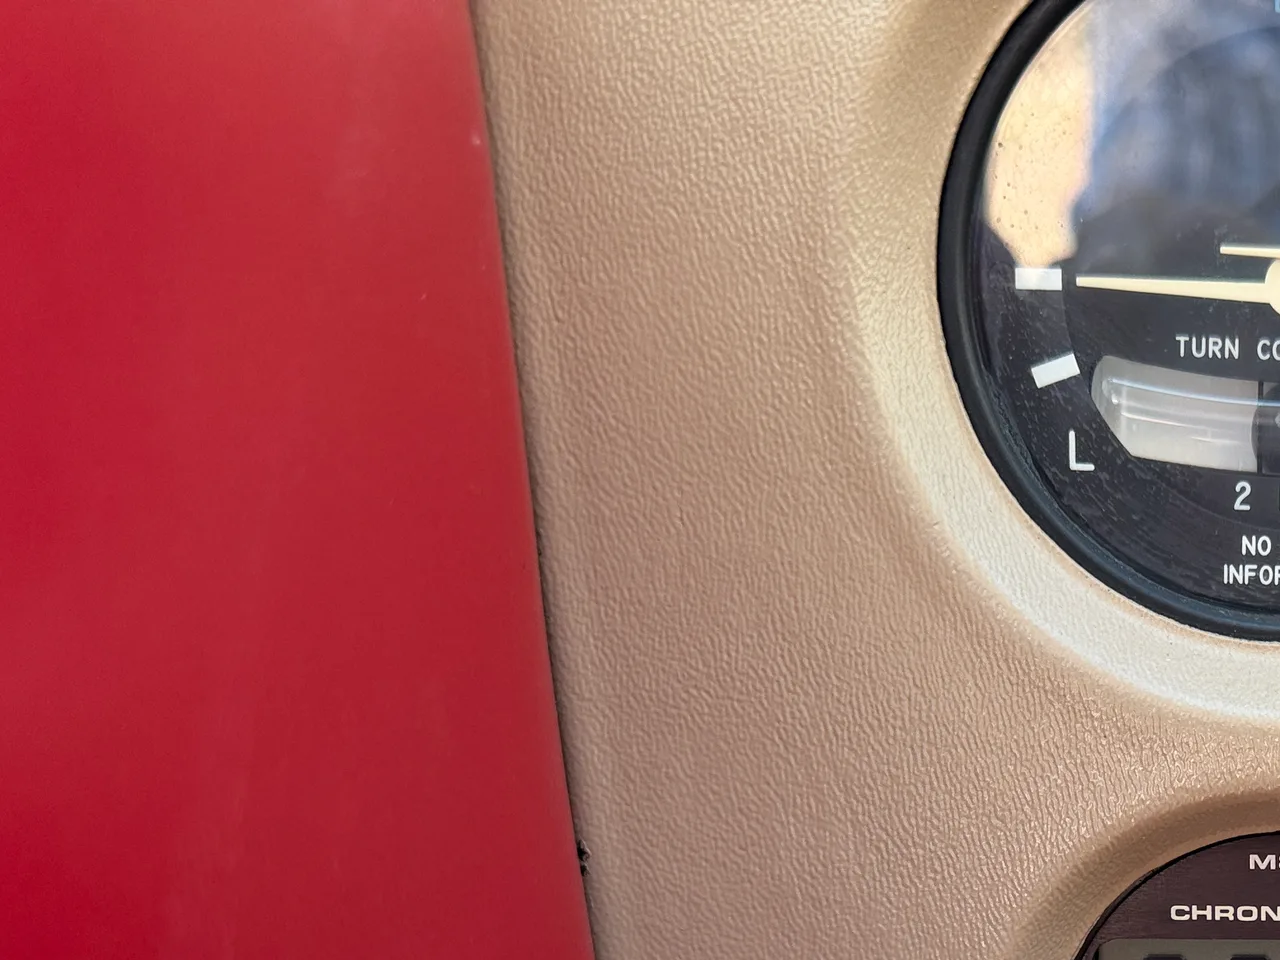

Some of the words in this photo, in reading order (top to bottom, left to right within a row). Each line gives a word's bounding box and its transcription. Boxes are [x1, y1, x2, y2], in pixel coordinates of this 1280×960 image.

[1176, 336, 1240, 360] TURN
[1069, 429, 1095, 472] L
[1233, 481, 1252, 511] 2
[1241, 535, 1271, 557] NO
